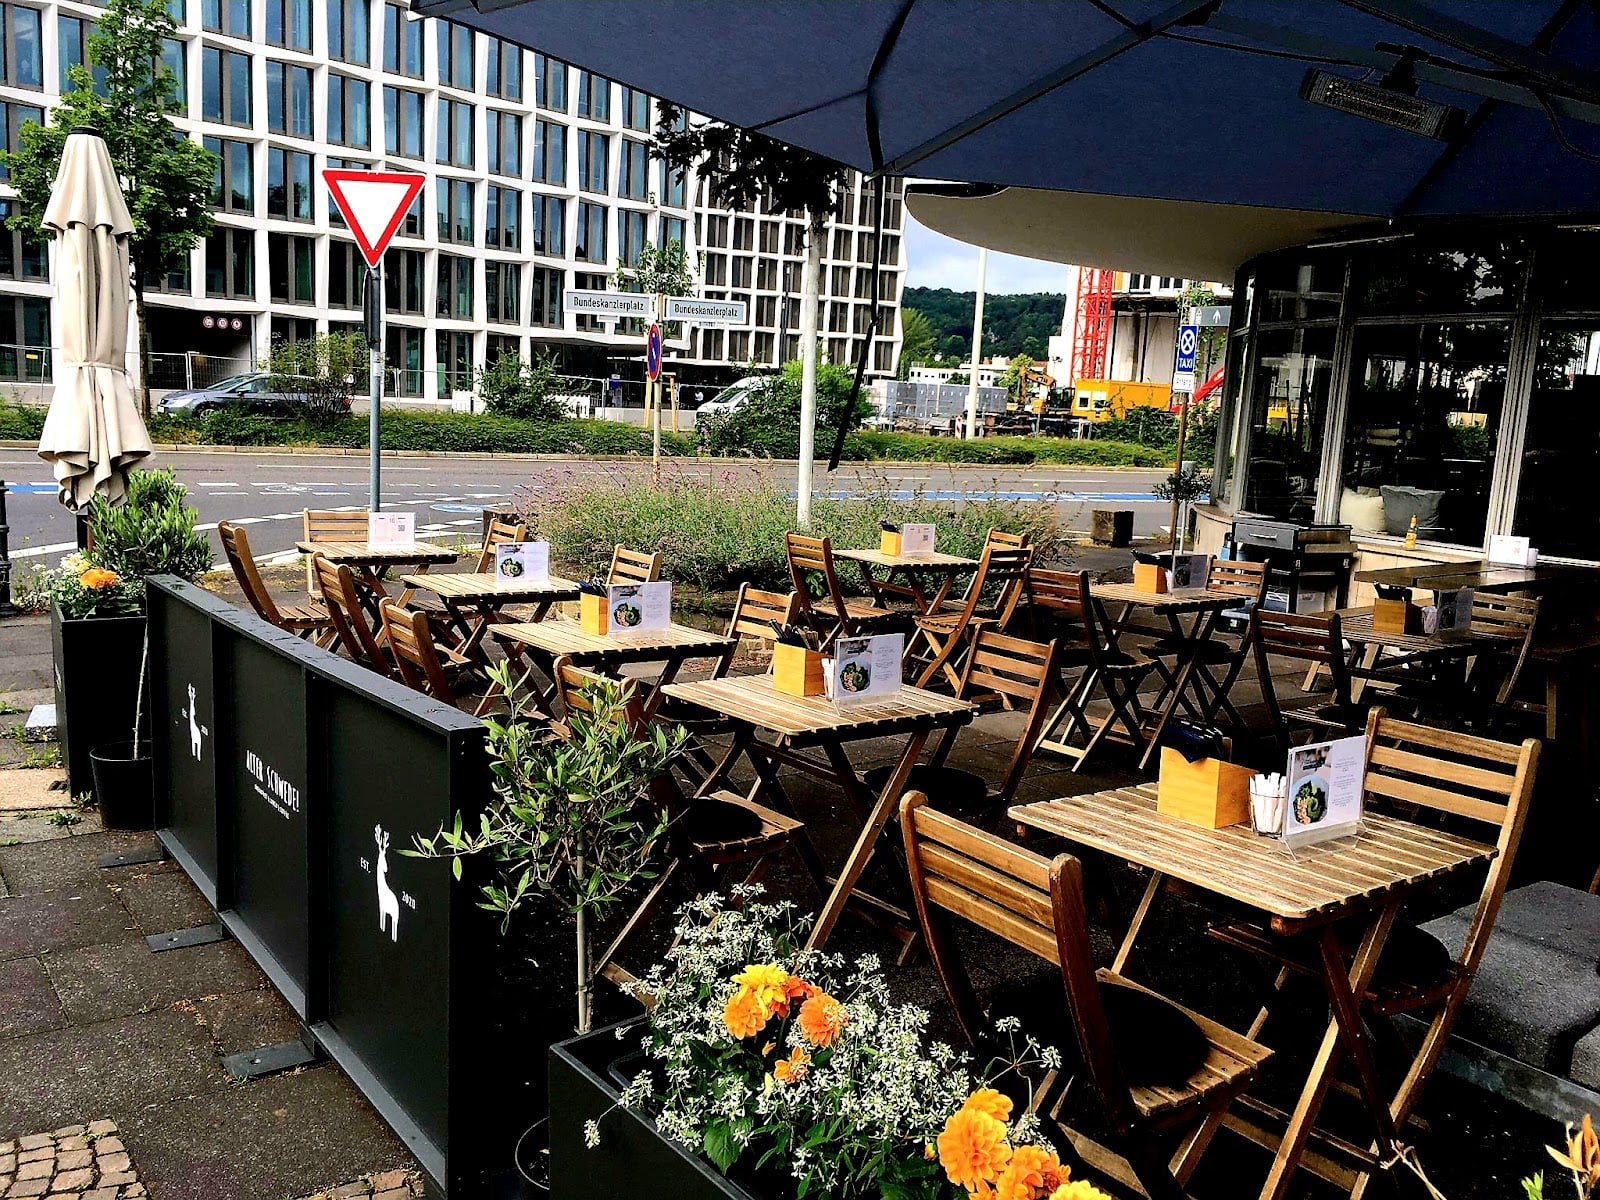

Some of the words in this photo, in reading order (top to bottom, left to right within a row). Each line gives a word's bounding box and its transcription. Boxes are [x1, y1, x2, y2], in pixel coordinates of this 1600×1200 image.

[573, 296, 644, 311] Bundeskanzlerplatz
[674, 303, 738, 318] Bundeskanzlerplatz
[1179, 358, 1193, 368] TAXI
[401, 890, 416, 910] 2020
